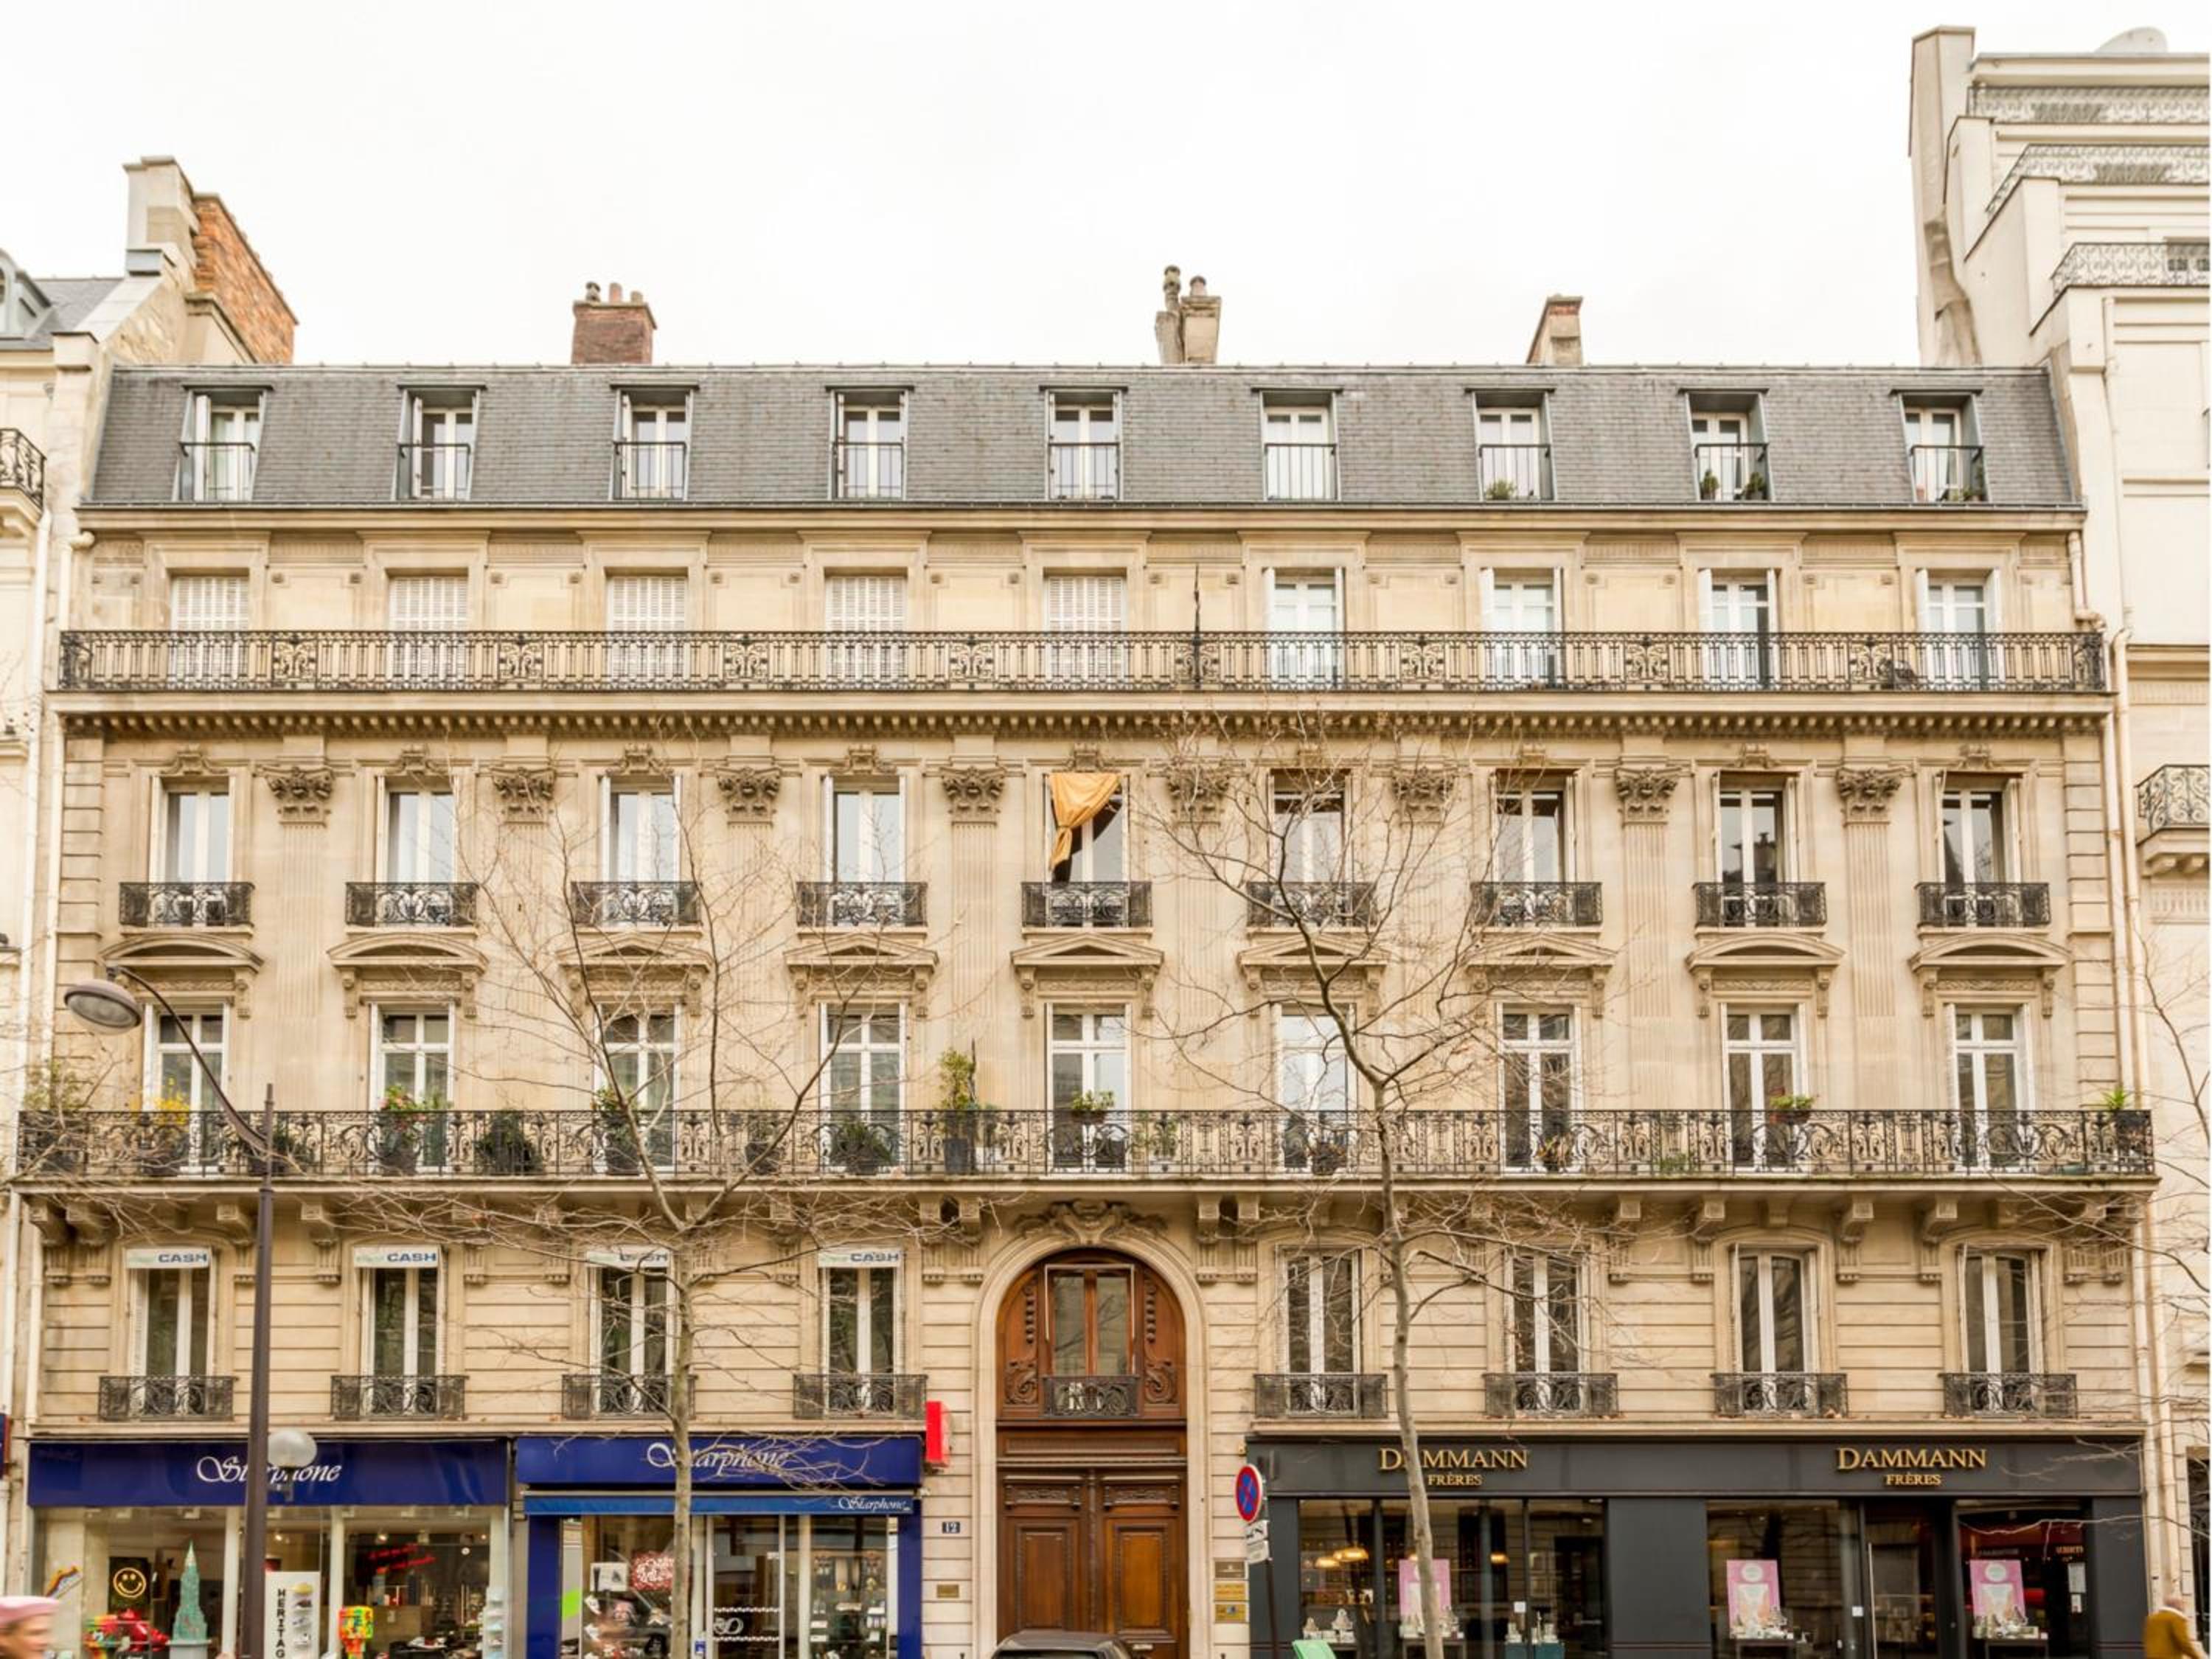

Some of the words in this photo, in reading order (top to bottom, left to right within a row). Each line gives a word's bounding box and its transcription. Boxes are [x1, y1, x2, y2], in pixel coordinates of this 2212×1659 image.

[159, 1254, 207, 1263] CASH
[387, 1253, 437, 1262] CASH
[850, 1253, 899, 1262] CASH
[1380, 1447, 1528, 1470] DMMANN
[1837, 1447, 1987, 1470] DAMMANN
[1427, 1471, 1484, 1486] FRÈRES
[1885, 1471, 1942, 1486] FRÈRES
[946, 1522, 957, 1533] 12
